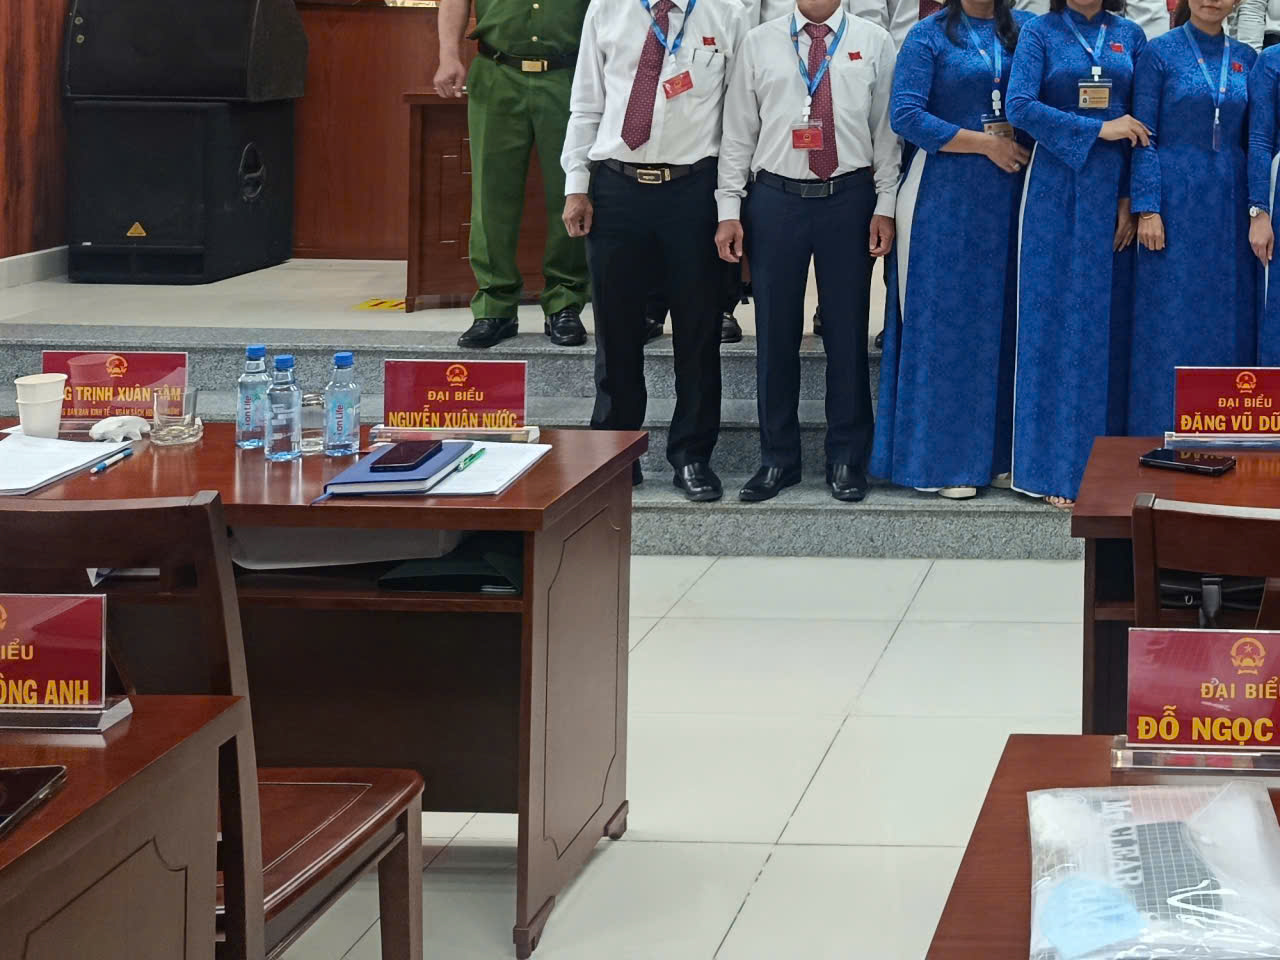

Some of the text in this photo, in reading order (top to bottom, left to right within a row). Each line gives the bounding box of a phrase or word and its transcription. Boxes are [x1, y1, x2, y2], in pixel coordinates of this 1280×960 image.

[76, 386, 114, 405] TRỊNH
[117, 384, 151, 402] XUÂN
[427, 387, 484, 403] ĐẠI BIỂU
[1218, 394, 1272, 409] ĐẠI BIỂU
[389, 405, 517, 429] NGUYỄN XUÂN NƯỚC
[1181, 411, 1226, 435] ĐẶNG
[1231, 411, 1251, 431] VŨ
[0, 638, 34, 661] IỂU
[44, 679, 89, 706] ANH
[1201, 680, 1236, 702] ĐẠI
[1137, 704, 1180, 741] ĐỖ
[1191, 716, 1273, 745] NGỌC
